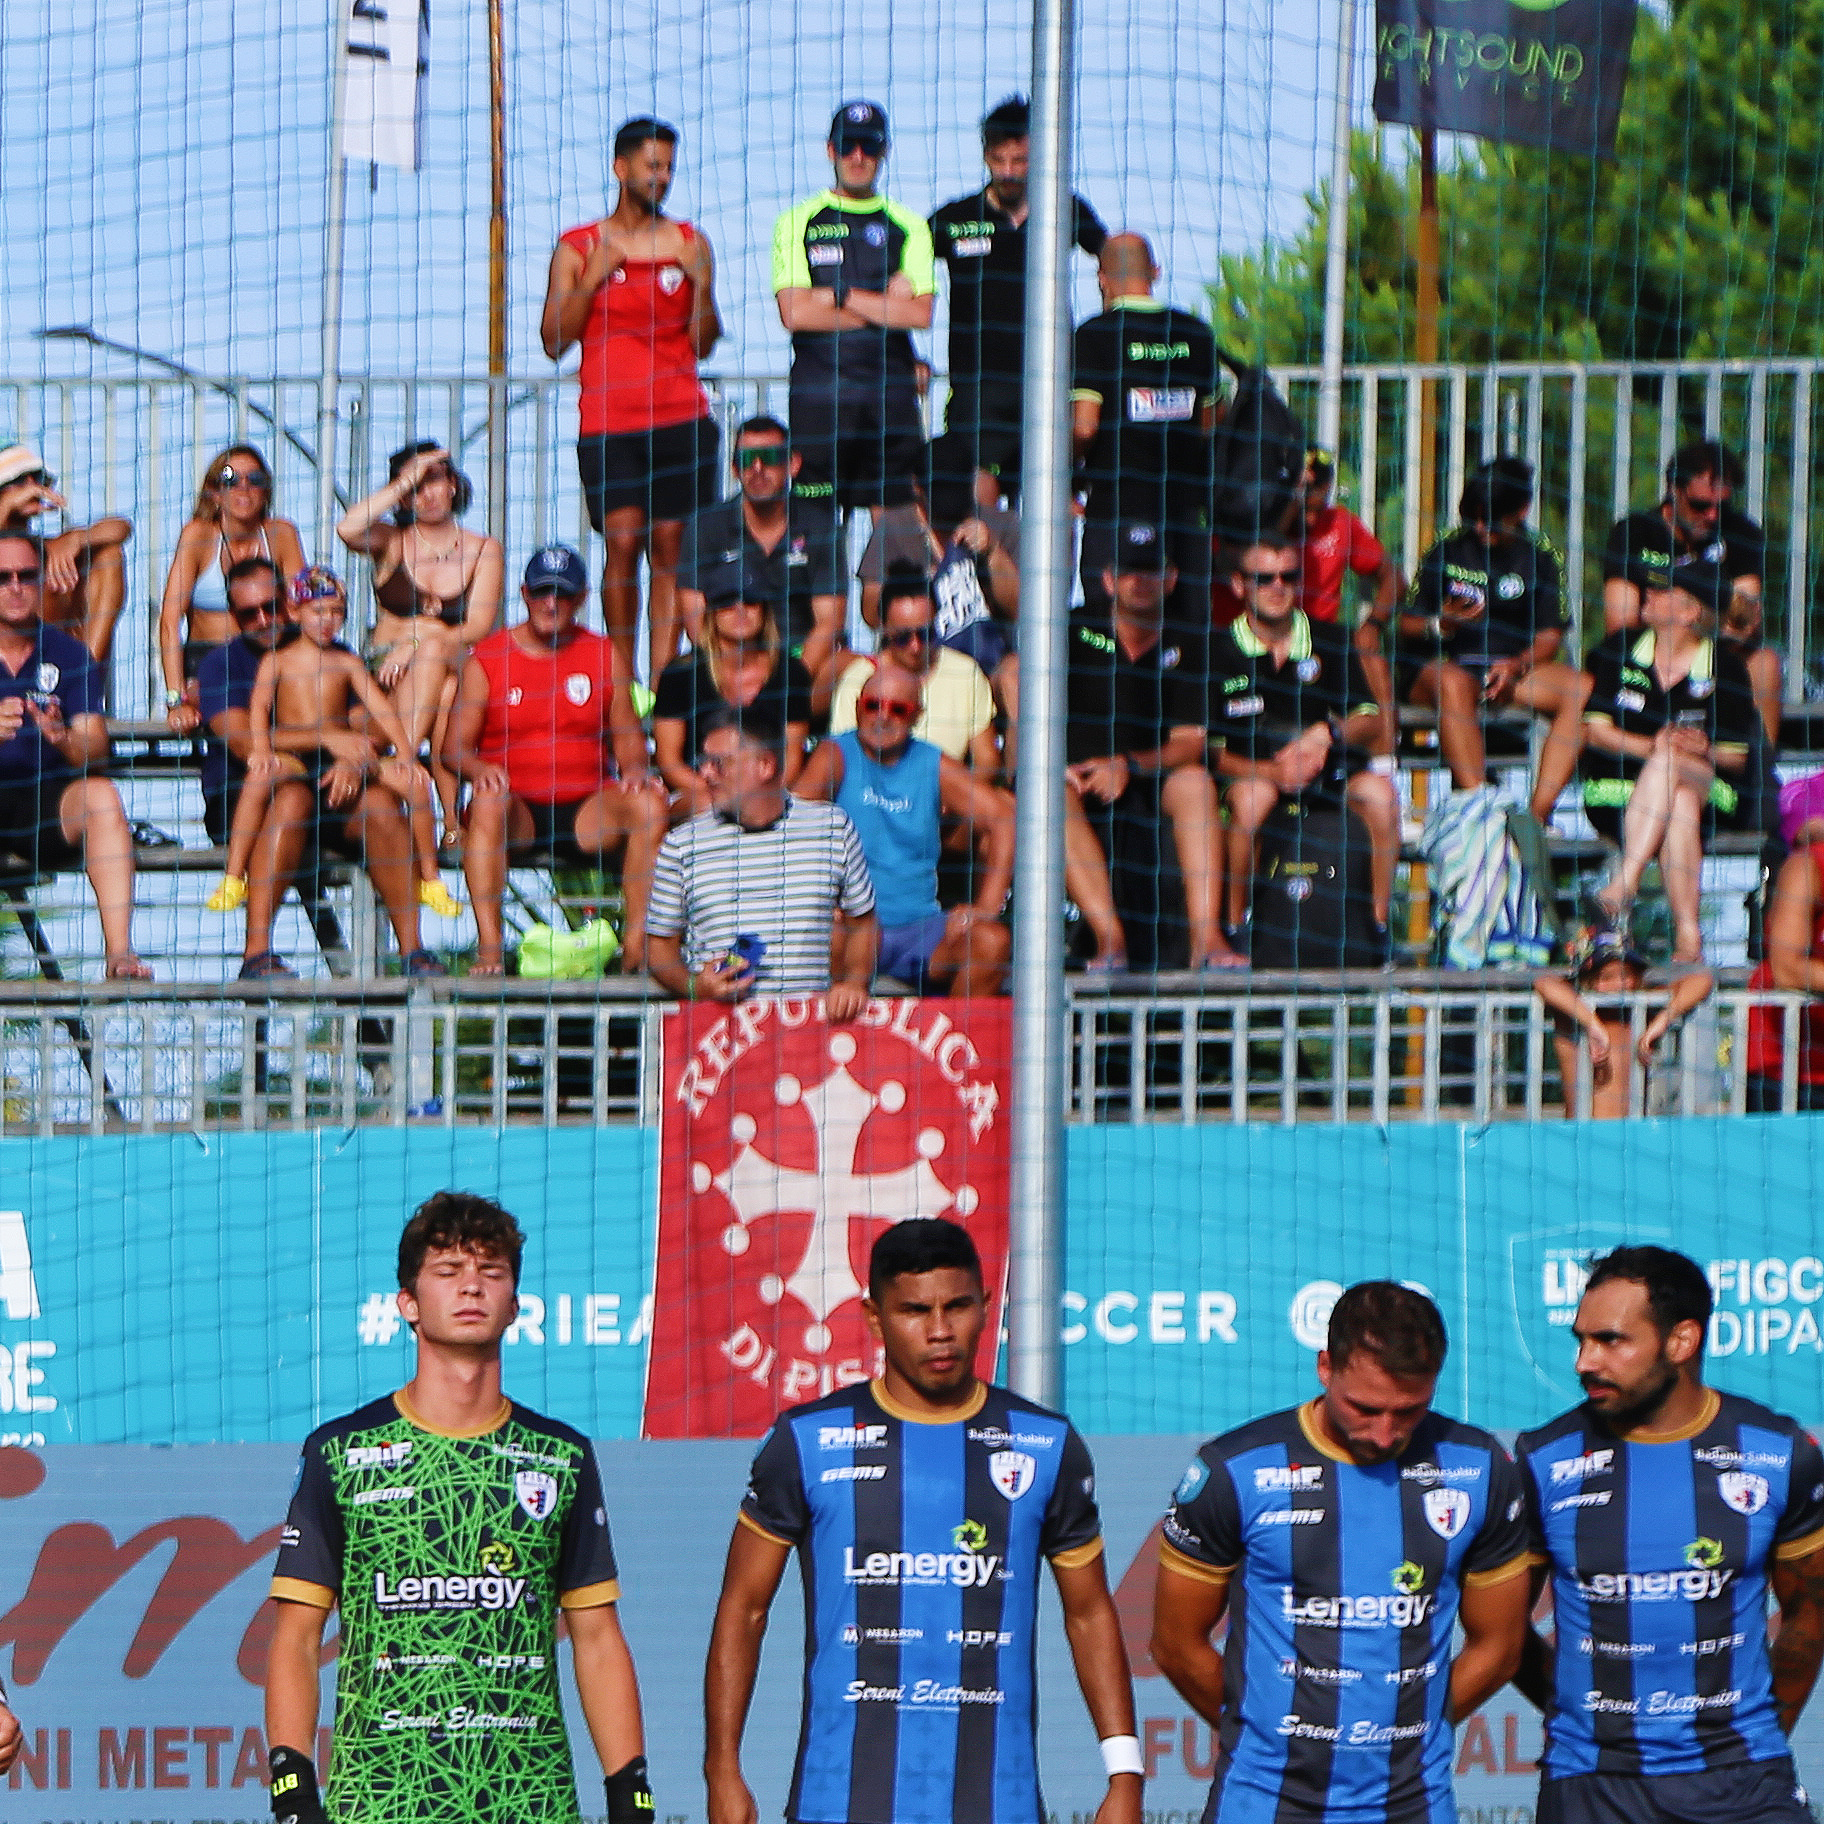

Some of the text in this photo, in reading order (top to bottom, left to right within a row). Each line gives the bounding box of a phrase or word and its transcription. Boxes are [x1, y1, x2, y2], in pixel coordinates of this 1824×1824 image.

[1378, 22, 1585, 84] IGHTSOUND
[1384, 61, 1575, 107] ERVICE
[677, 994, 1001, 1145] REPUBLICA
[1708, 1256, 1824, 1306] FIGC
[1709, 1307, 1824, 1358] DIPA
[821, 1465, 887, 1483] GEMS
[354, 1486, 416, 1506] GEMS
[845, 1547, 1000, 1588] Lenergy
[375, 1572, 526, 1609] Lenergy
[1281, 1586, 1432, 1627] Lenergy
[477, 1655, 545, 1668] HOPE
